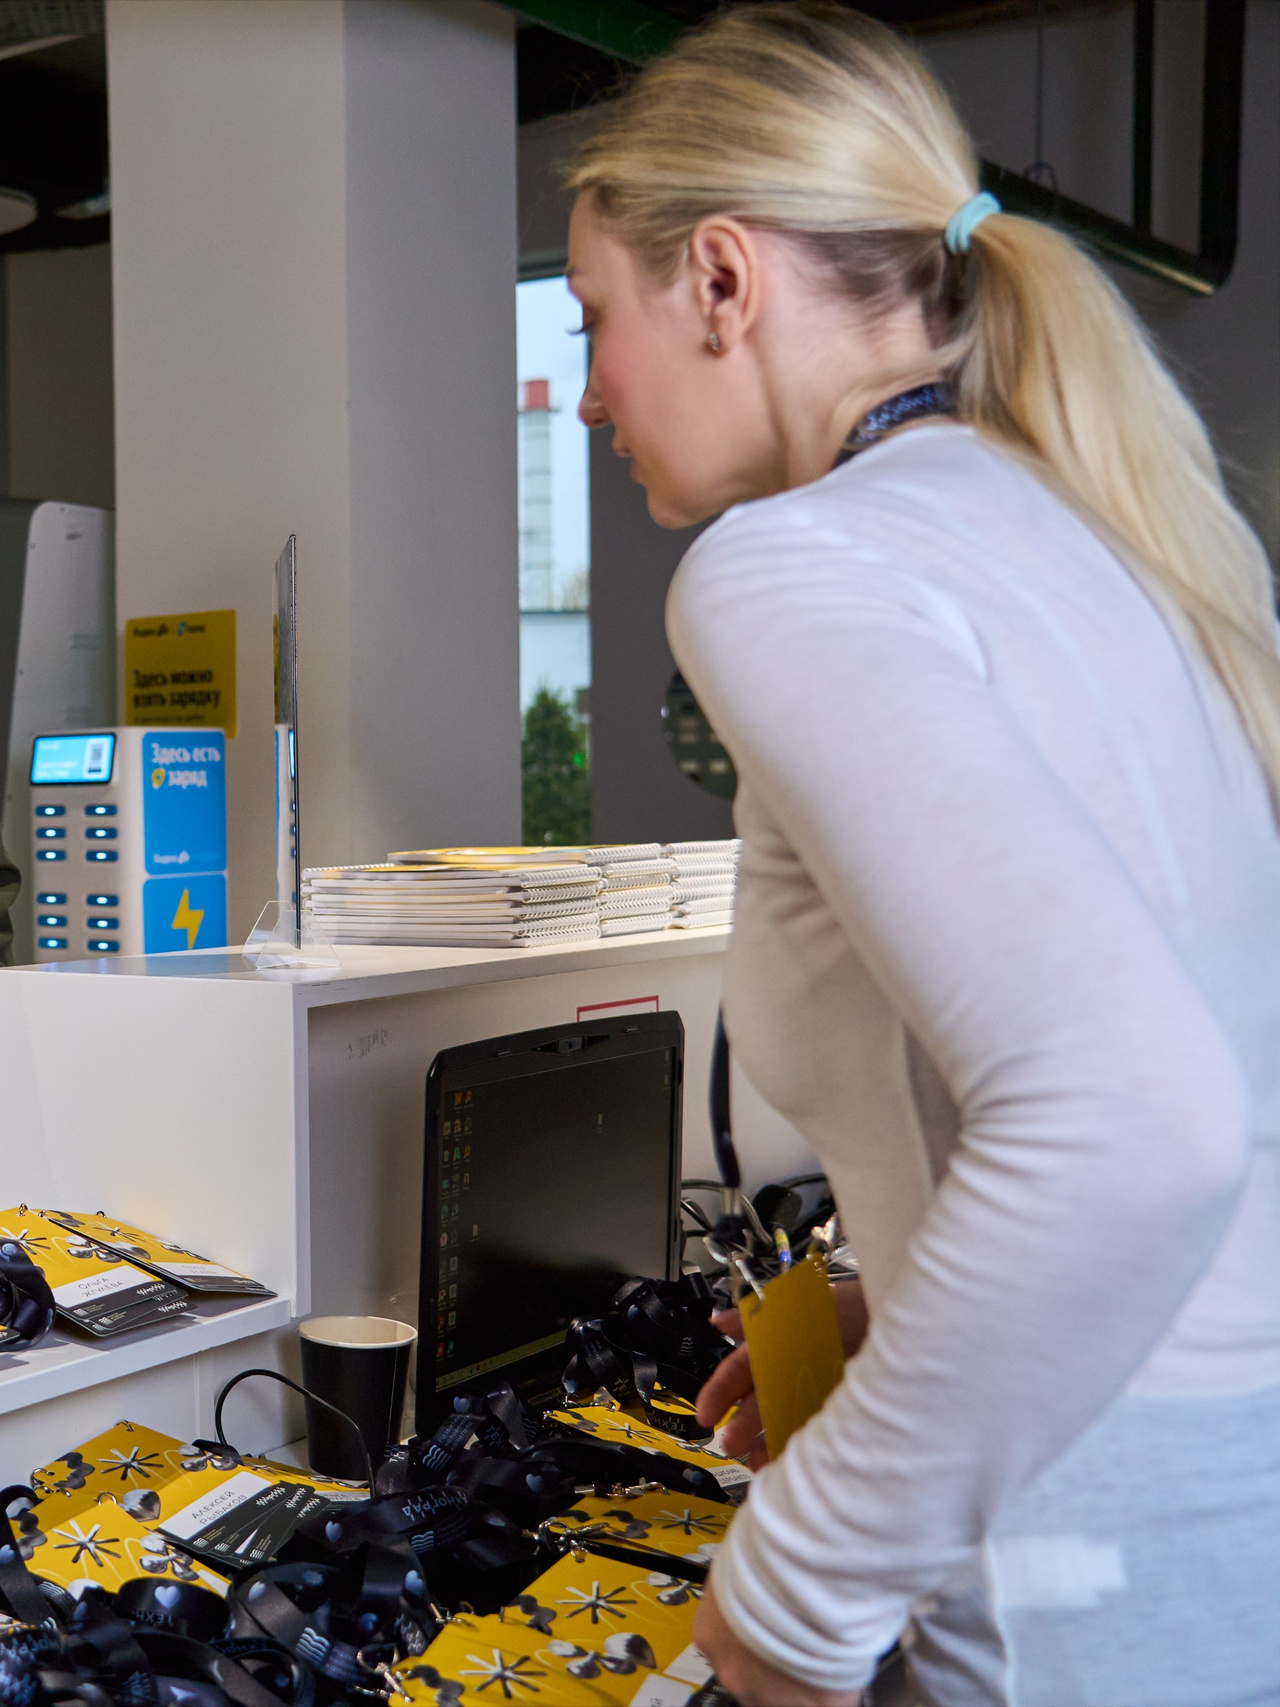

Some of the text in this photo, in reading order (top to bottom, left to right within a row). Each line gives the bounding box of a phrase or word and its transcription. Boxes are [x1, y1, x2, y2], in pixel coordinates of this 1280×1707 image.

[133, 669, 214, 689] Здесь можно
[133, 690, 222, 710] взять зарядку
[151, 742, 221, 765] Здесь есть
[167, 769, 208, 790] заряд
[77, 1277, 110, 1290] ОЛЬГА
[191, 1490, 235, 1519] АЛЕКСЕЙ
[199, 1494, 247, 1525] РЫБАКОВ
[401, 1490, 468, 1521] ХНОГРАД
